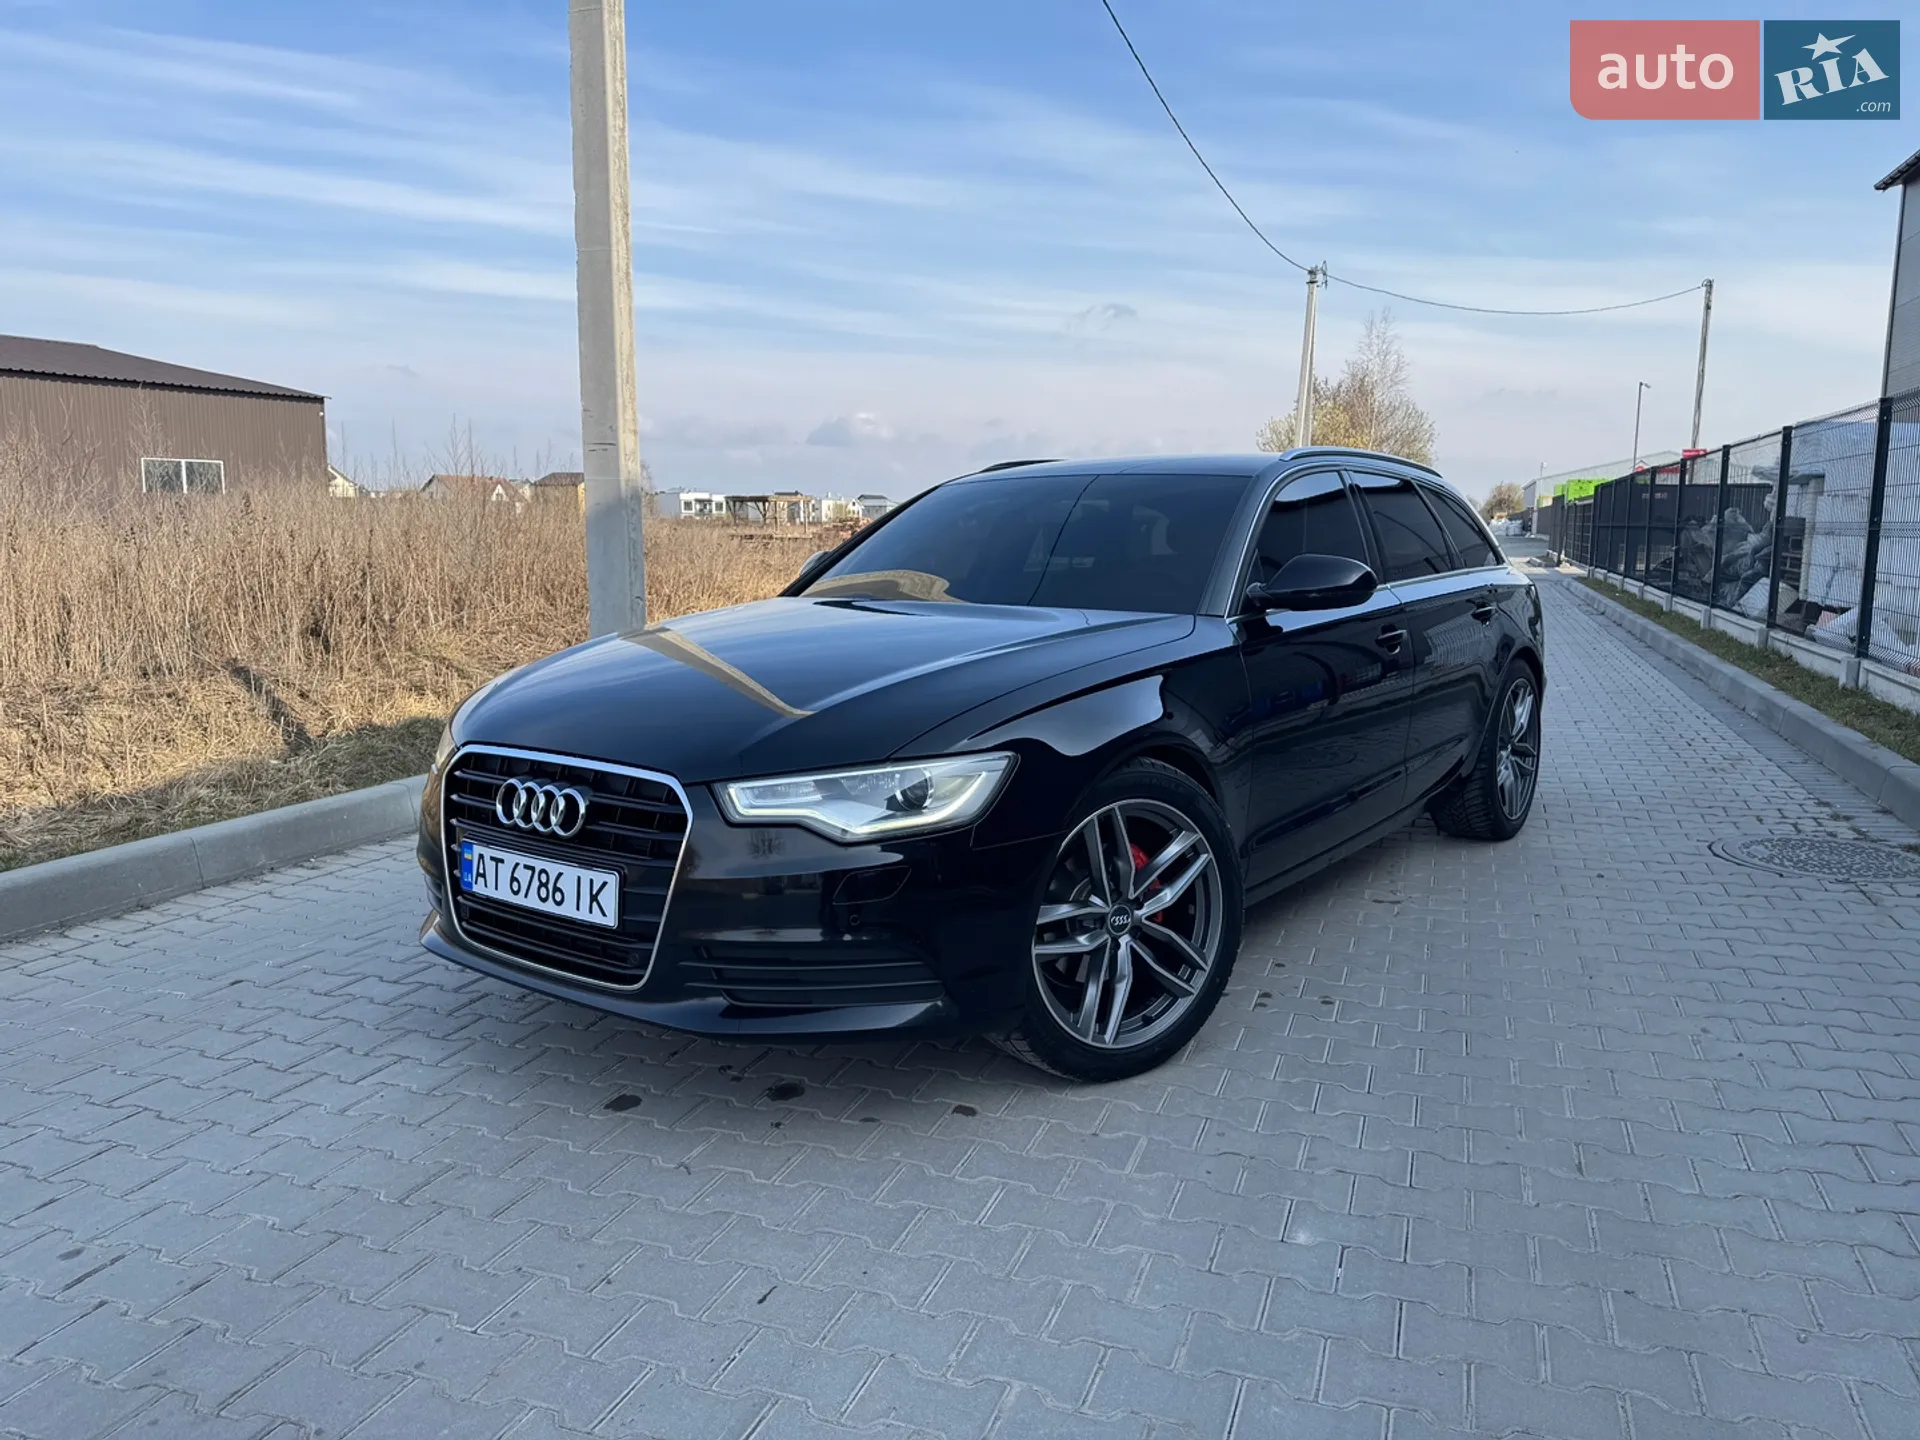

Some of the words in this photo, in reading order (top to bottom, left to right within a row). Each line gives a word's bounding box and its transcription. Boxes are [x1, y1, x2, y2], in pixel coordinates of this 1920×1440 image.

[474, 852, 505, 891] AT
[509, 861, 565, 907] 6786
[575, 875, 609, 918] IK
